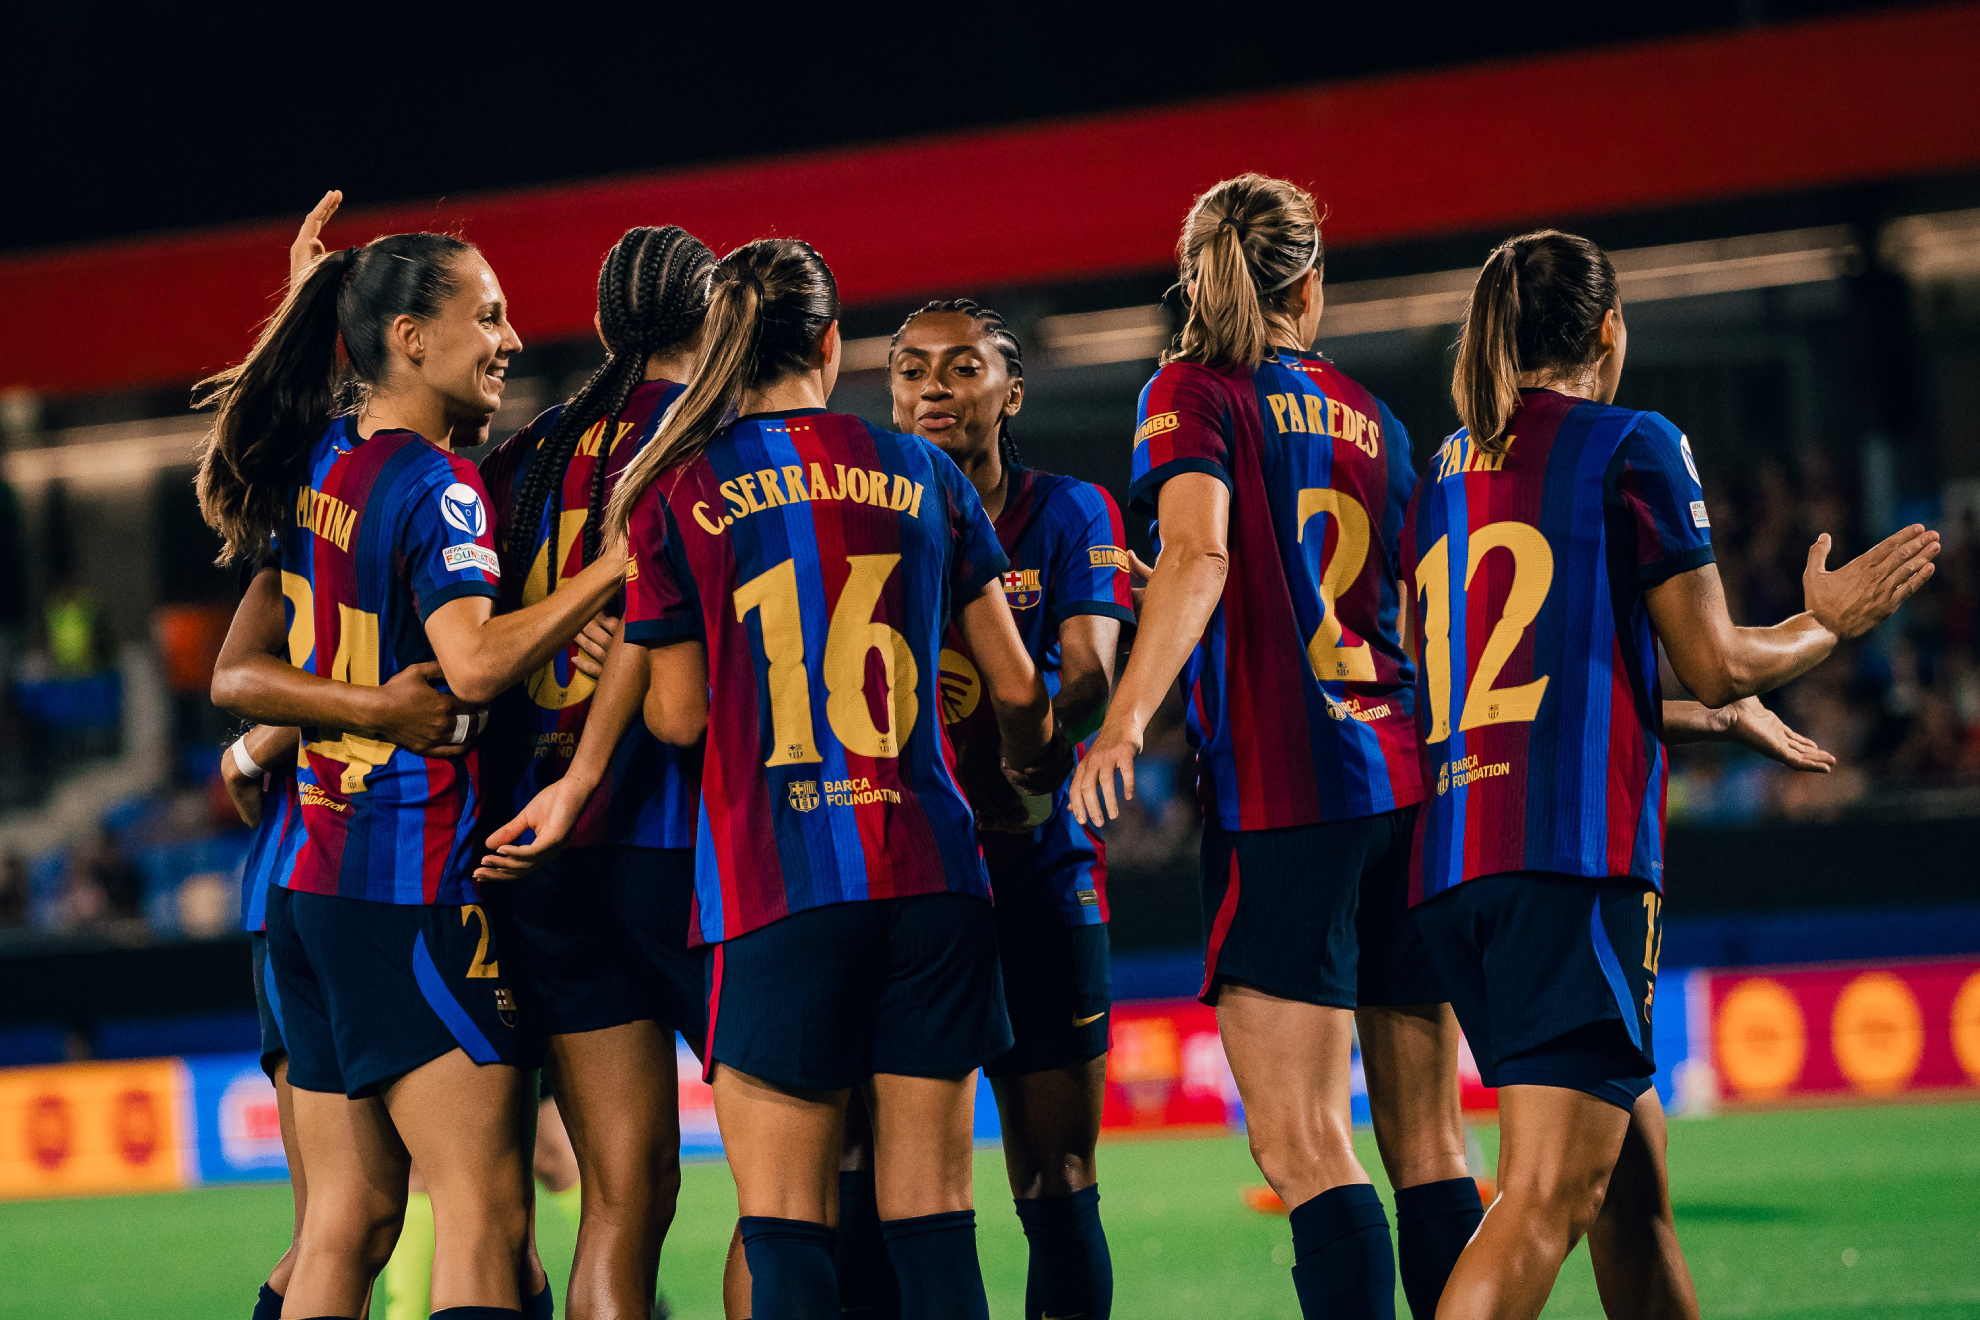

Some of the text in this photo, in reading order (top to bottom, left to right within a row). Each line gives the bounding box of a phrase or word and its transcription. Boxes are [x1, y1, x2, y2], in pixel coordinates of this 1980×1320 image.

[1266, 393, 1379, 459] PAREDES
[692, 462, 925, 536] C.SERRAJORDI
[1297, 488, 1377, 682] 2
[732, 553, 919, 768] 16
[1415, 520, 1555, 745] 12
[298, 781, 325, 796] ARÇA
[824, 777, 871, 794] BARÇA
[826, 788, 901, 806] FOUNDATN
[1452, 754, 1479, 775] BARÇA
[1452, 762, 1510, 789] FOUNDATION
[461, 904, 499, 979] 2
